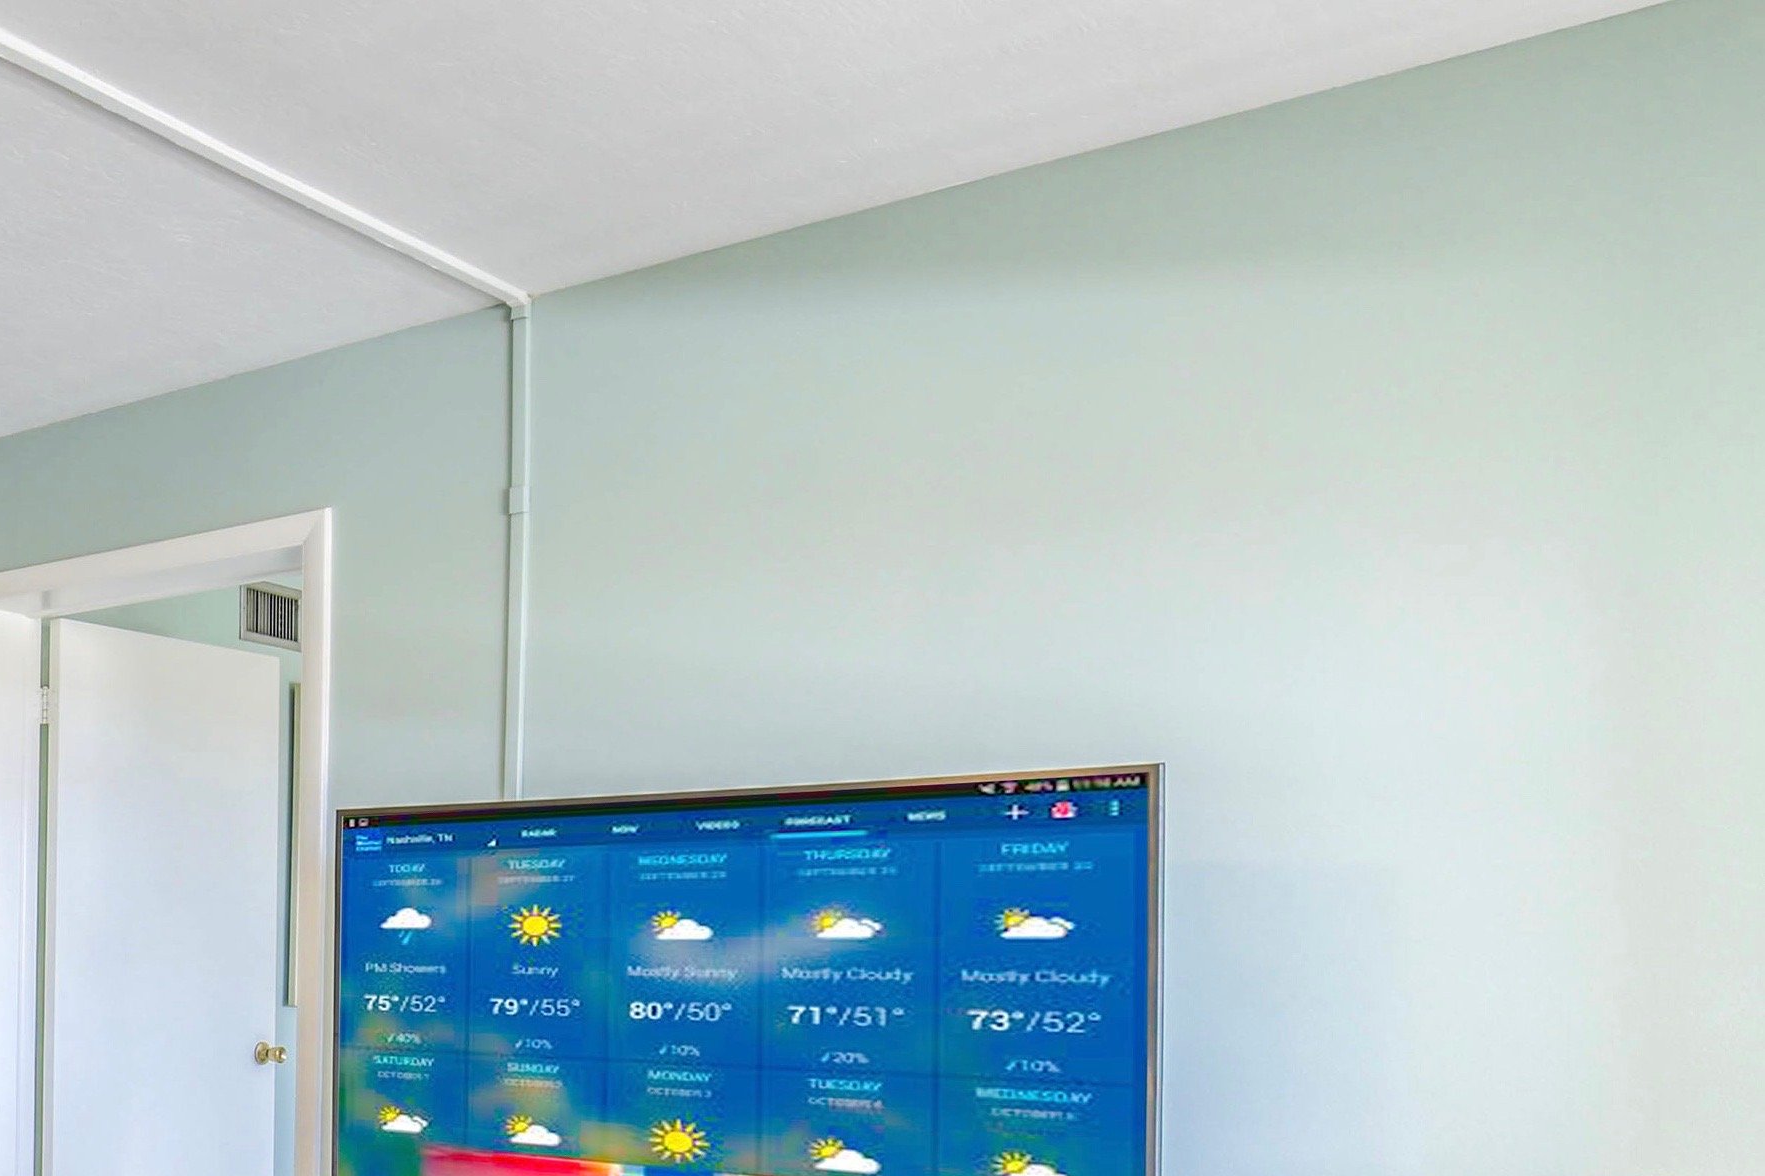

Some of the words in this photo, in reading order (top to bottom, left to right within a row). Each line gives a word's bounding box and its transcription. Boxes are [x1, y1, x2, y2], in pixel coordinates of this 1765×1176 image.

[803, 848, 892, 860] THURSDAY
[1001, 841, 1069, 856] FRIDAY
[507, 858, 567, 870] TUESDAY
[637, 853, 728, 866] WEDNESDAY
[388, 863, 427, 873] TODAY
[364, 962, 388, 974] PM
[389, 961, 446, 975] Showers
[511, 964, 559, 979] Sunny
[627, 965, 680, 981] Mostly
[684, 966, 738, 982] Sunny
[780, 966, 843, 984] Mostly
[846, 966, 914, 985] Cloudy
[961, 969, 1031, 987] Mostly
[1034, 968, 1112, 988] Cloudy
[373, 1055, 435, 1067] SATURDAY
[506, 1062, 560, 1074] SUNDAY
[647, 1069, 713, 1082] MONDAY
[808, 1078, 882, 1091] TUESDAY
[975, 1087, 1093, 1103] WEDNESDAY
